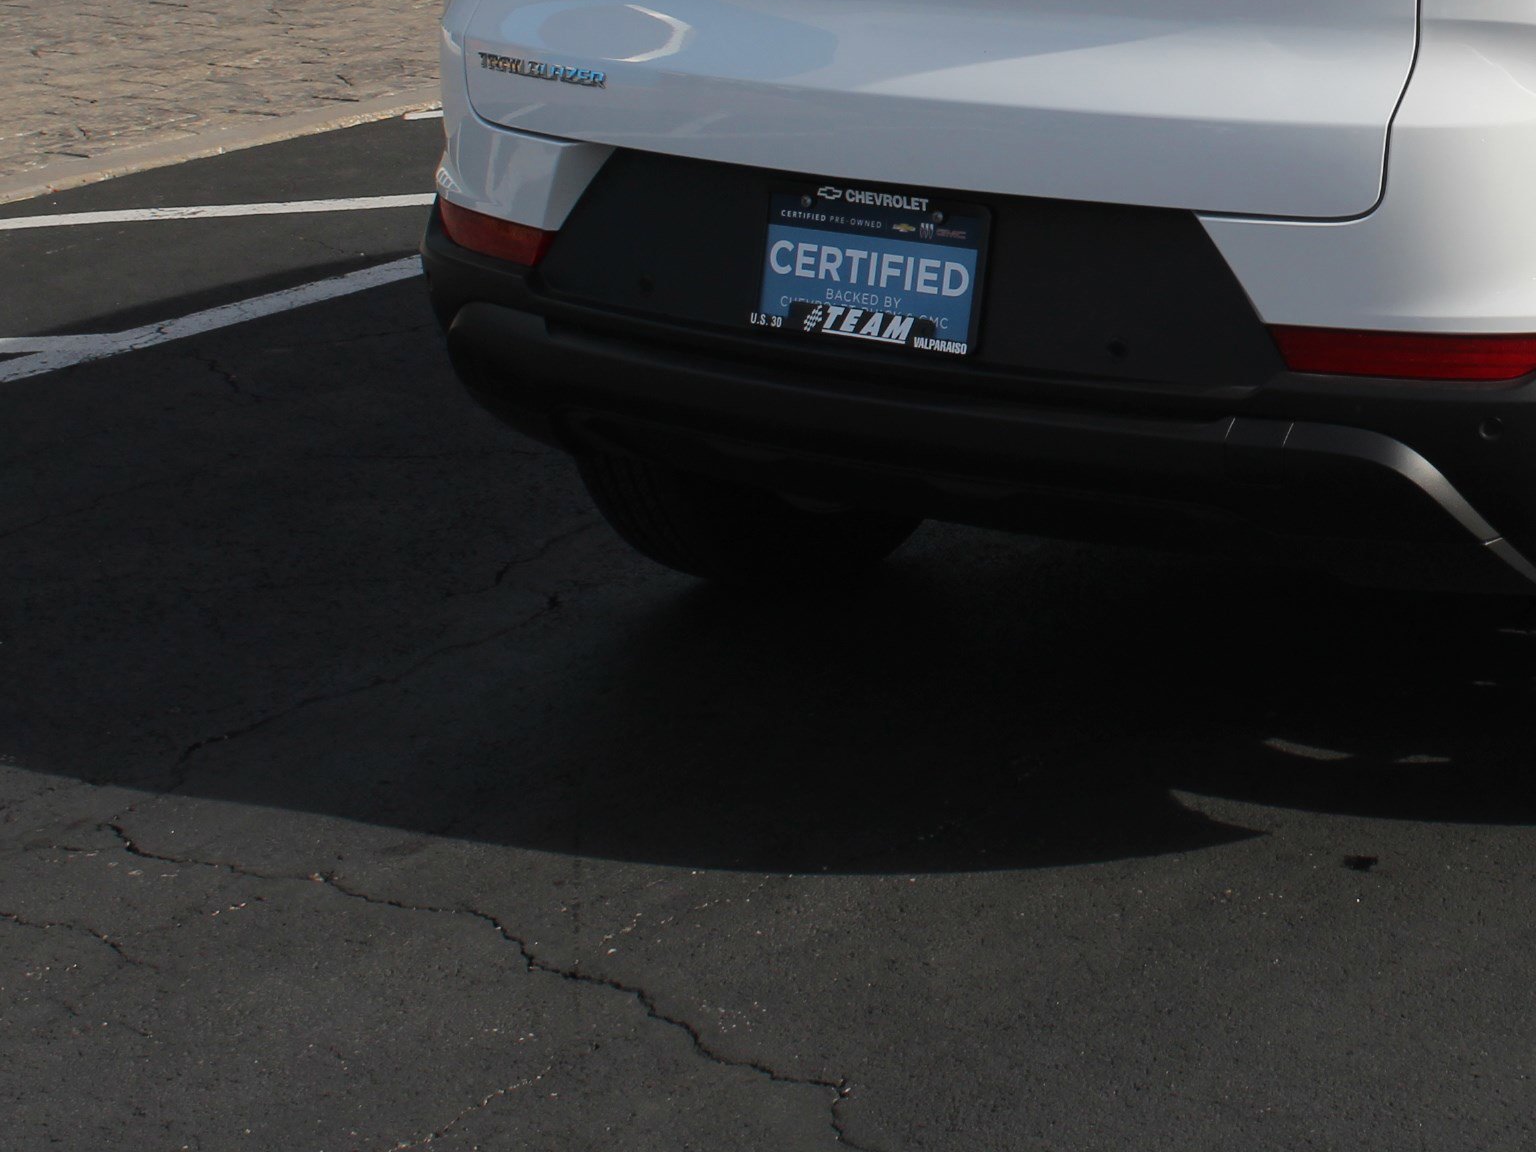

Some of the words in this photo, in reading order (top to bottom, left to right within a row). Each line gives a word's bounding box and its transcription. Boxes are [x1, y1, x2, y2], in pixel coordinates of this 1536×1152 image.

[845, 189, 929, 212] CHEVROLET
[780, 209, 827, 222] CERTIFIED
[829, 215, 883, 229] PRE-OWNED
[936, 228, 967, 240] GMC
[769, 239, 970, 298] CERTIFIED
[825, 288, 879, 306] BACKED
[883, 296, 902, 309] BY
[750, 312, 768, 326] U.S.
[770, 315, 783, 328] 30
[821, 305, 915, 341] TEAM
[913, 336, 968, 356] VALPARAISO
